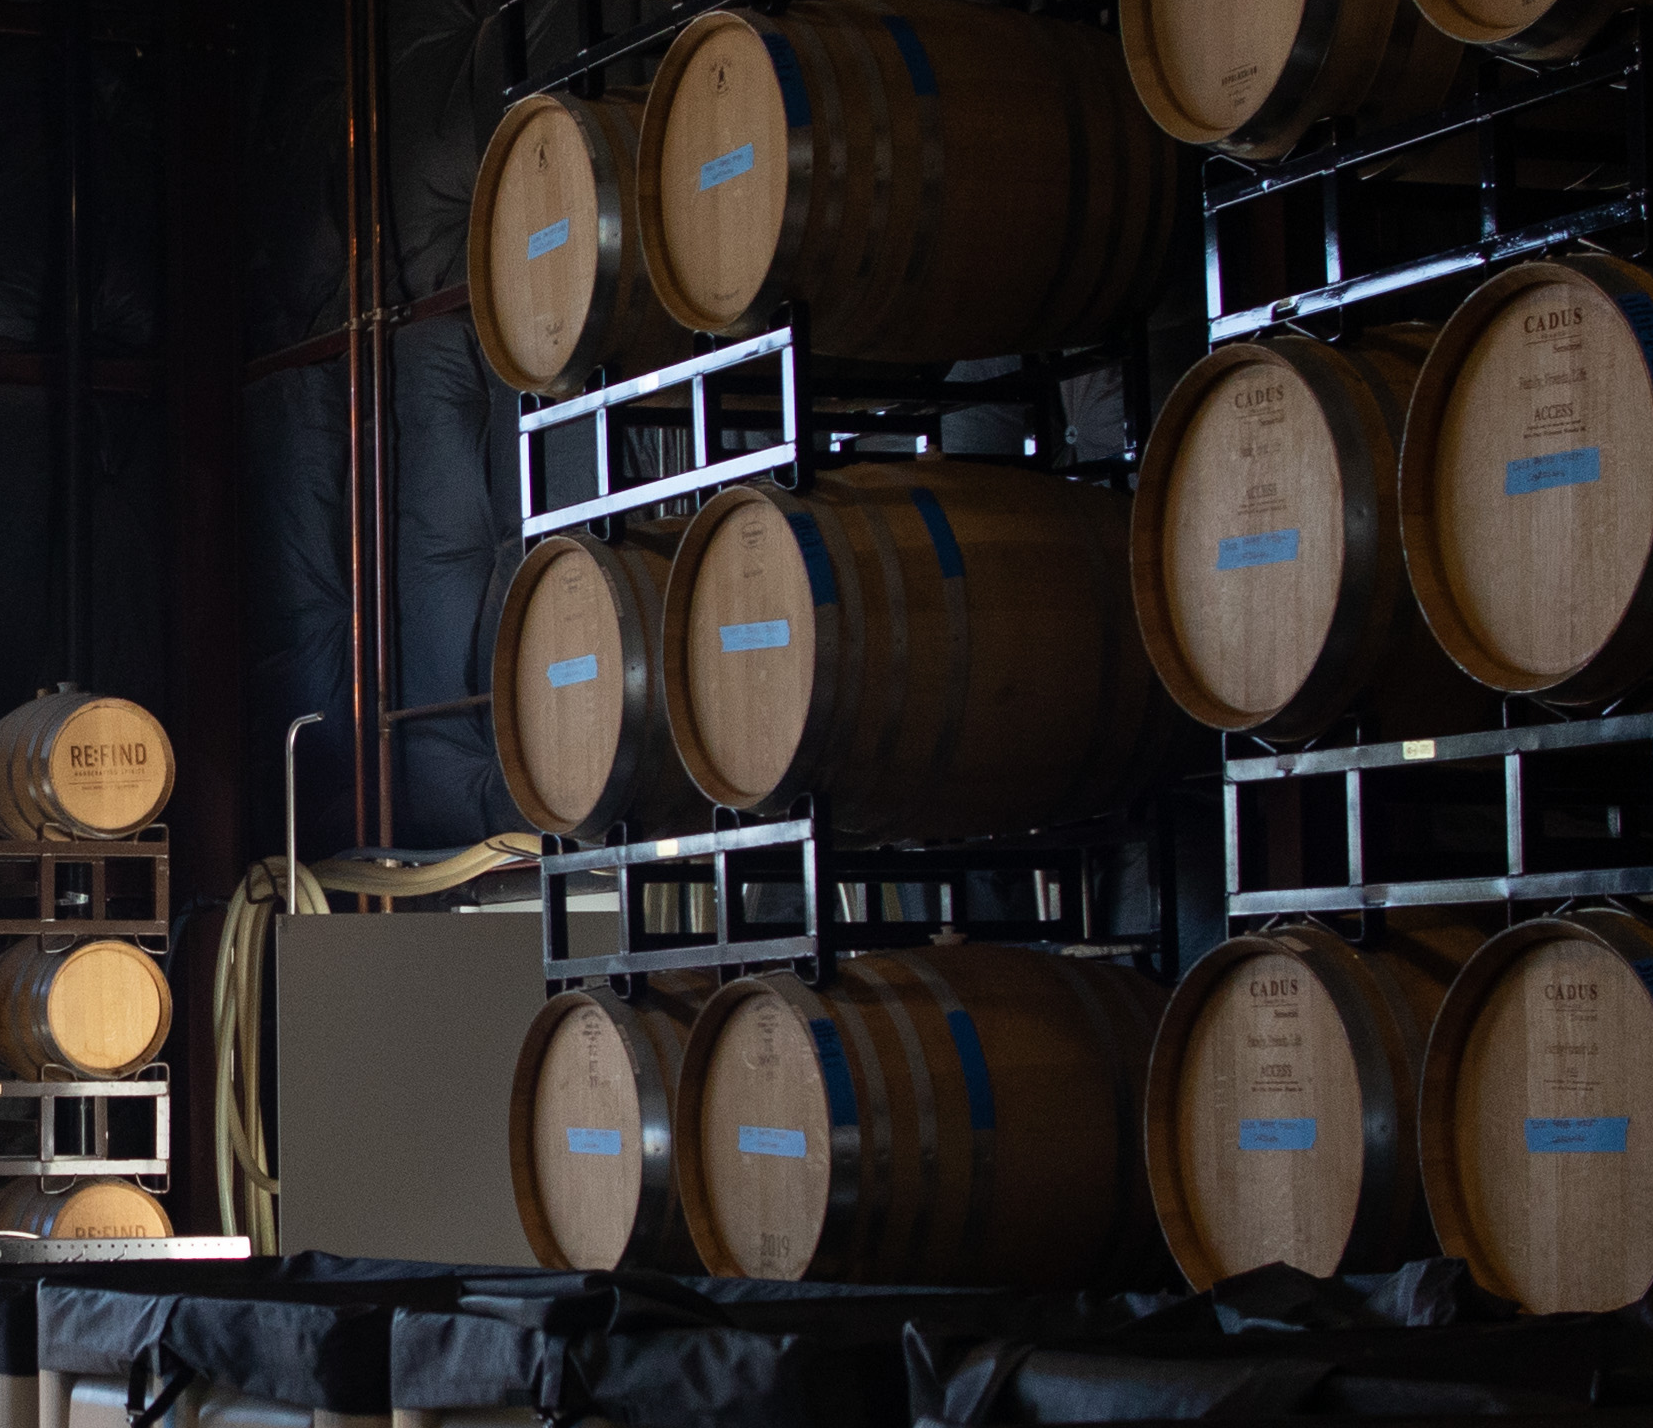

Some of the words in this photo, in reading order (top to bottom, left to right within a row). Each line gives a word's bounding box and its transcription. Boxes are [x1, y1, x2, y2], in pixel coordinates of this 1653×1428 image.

[1523, 306, 1583, 334] CADUS
[1234, 384, 1284, 409] CADUS
[70, 743, 147, 769] RE:FIND
[1250, 979, 1298, 998] CADUS
[1544, 983, 1598, 1001] CADUS
[761, 1232, 790, 1258] 2019
